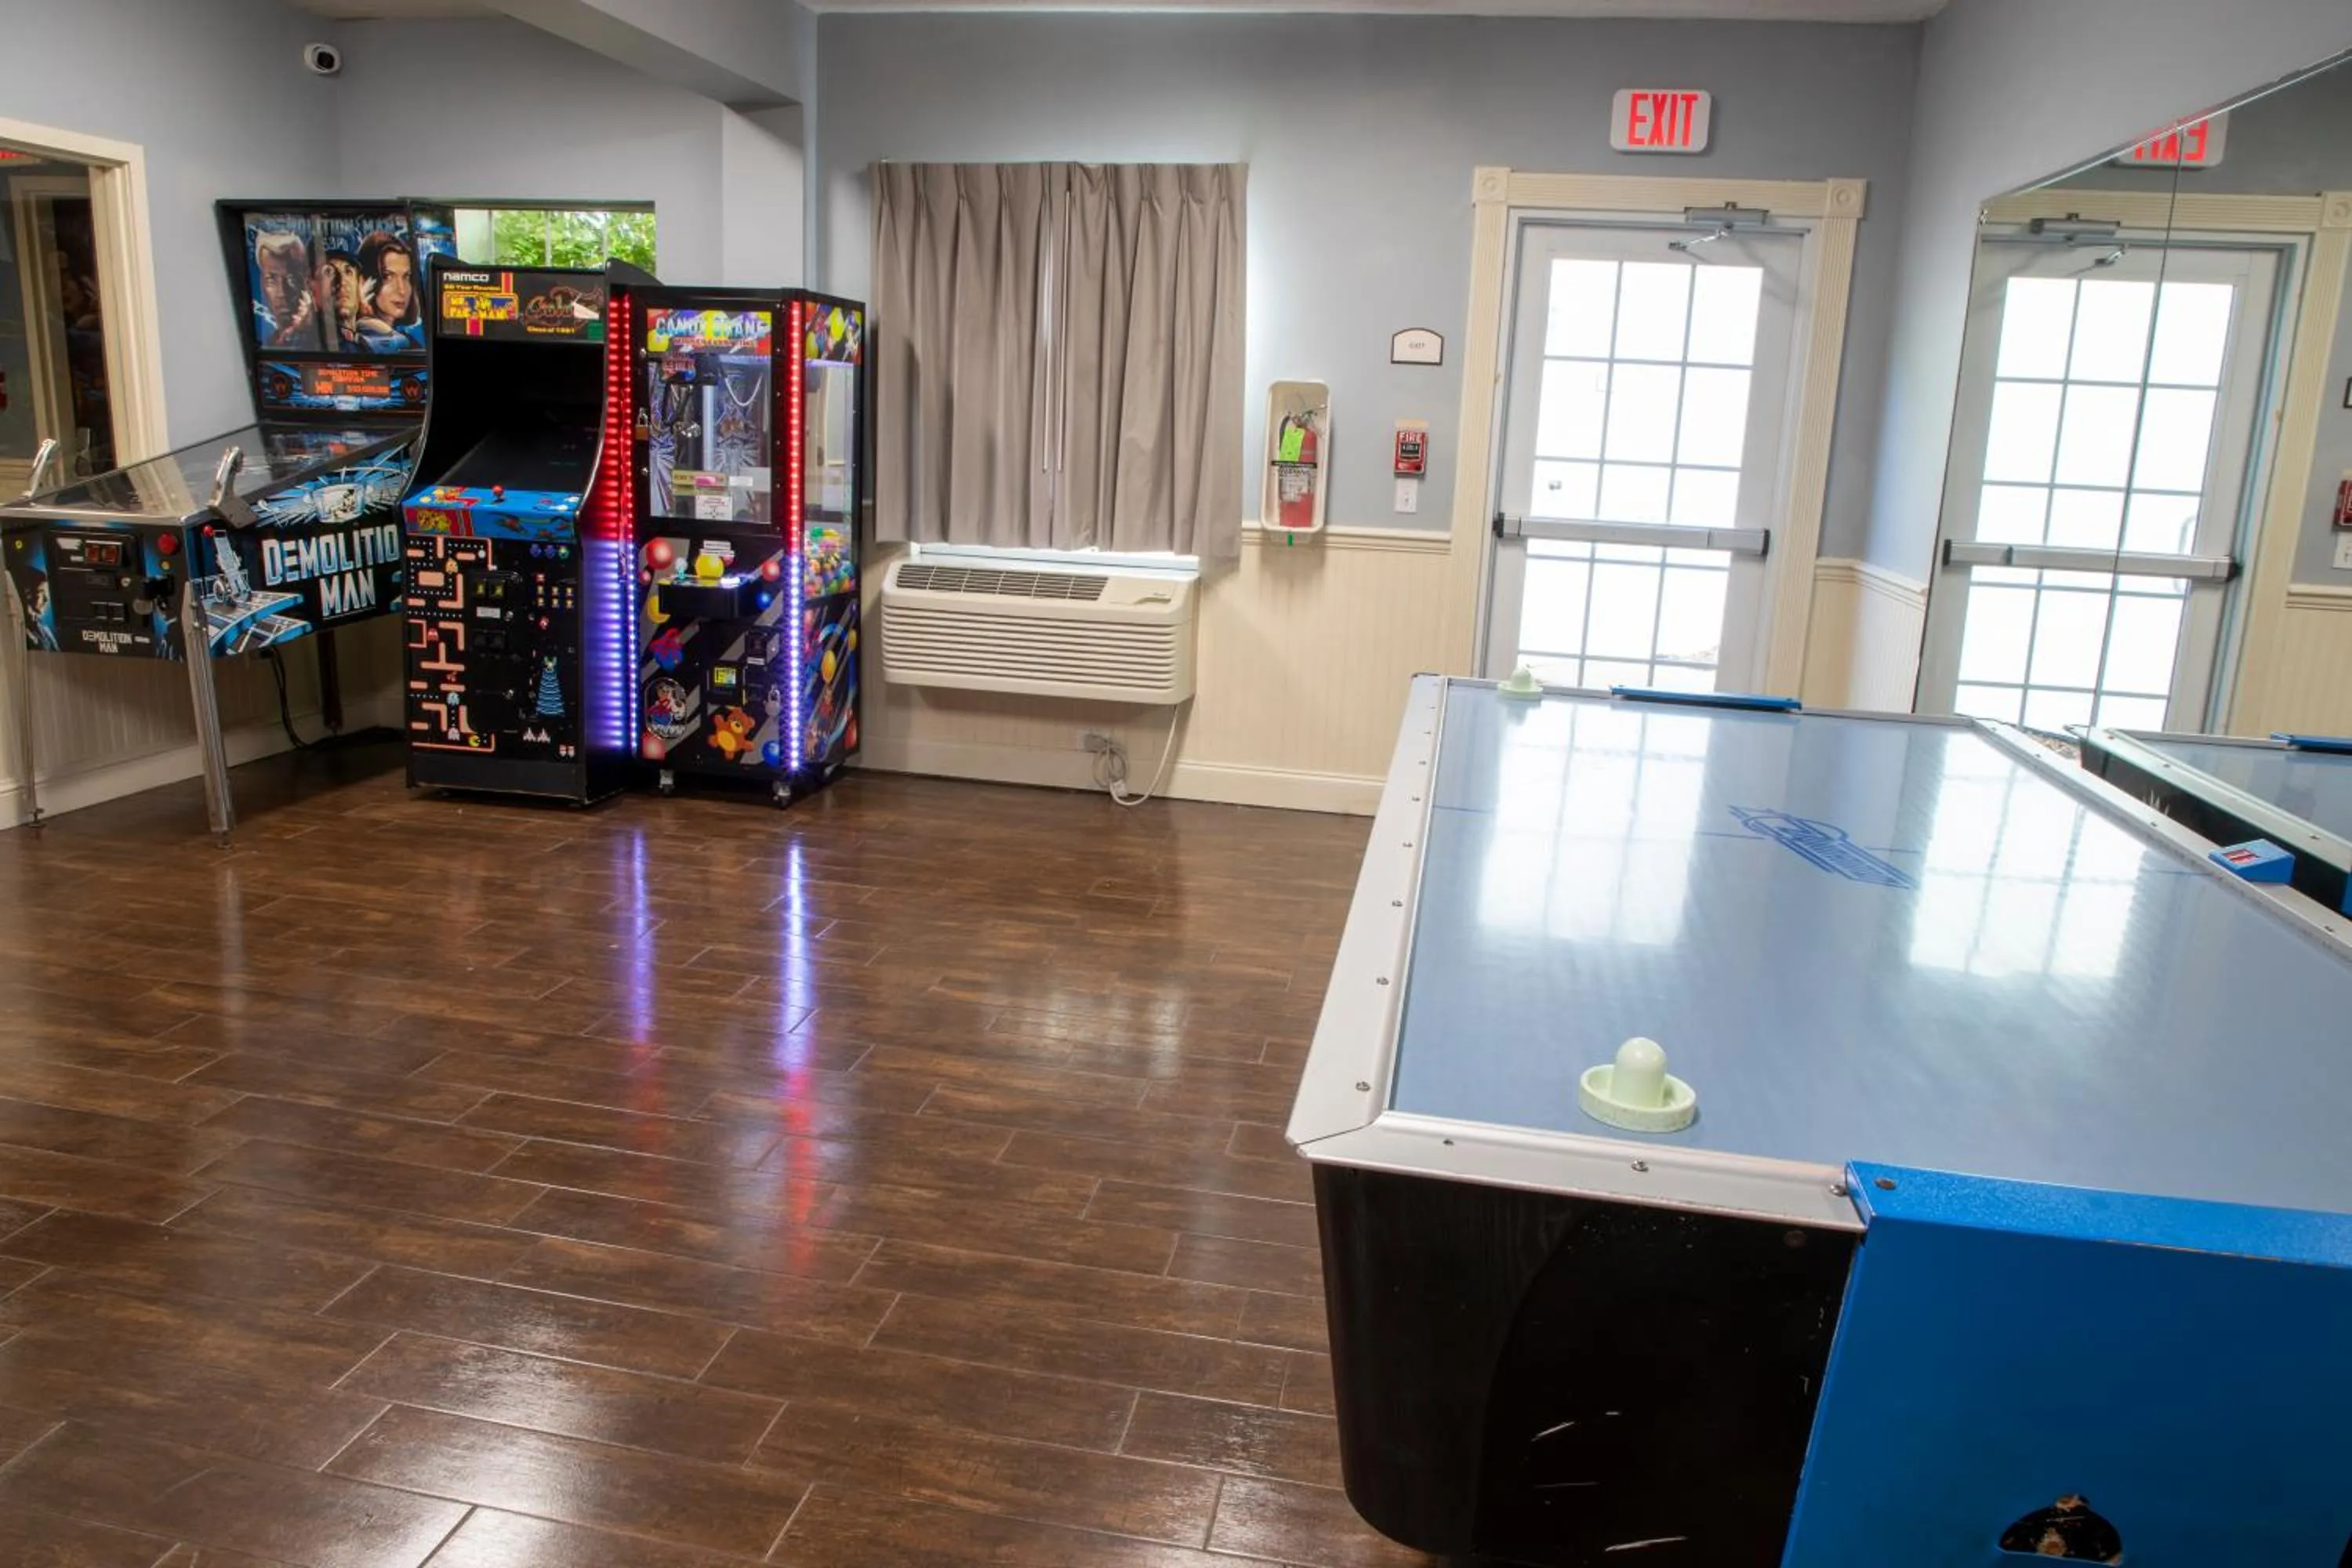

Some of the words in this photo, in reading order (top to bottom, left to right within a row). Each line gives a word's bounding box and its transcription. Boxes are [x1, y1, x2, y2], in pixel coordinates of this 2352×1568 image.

[1627, 93, 1700, 147] EXIT
[443, 271, 490, 282] namco
[1399, 432, 1421, 442] FIRE
[261, 524, 400, 586] DEMOLITIO
[319, 568, 376, 617] MAN
[82, 630, 132, 644] DEMOLITION
[98, 641, 118, 652] MAN
